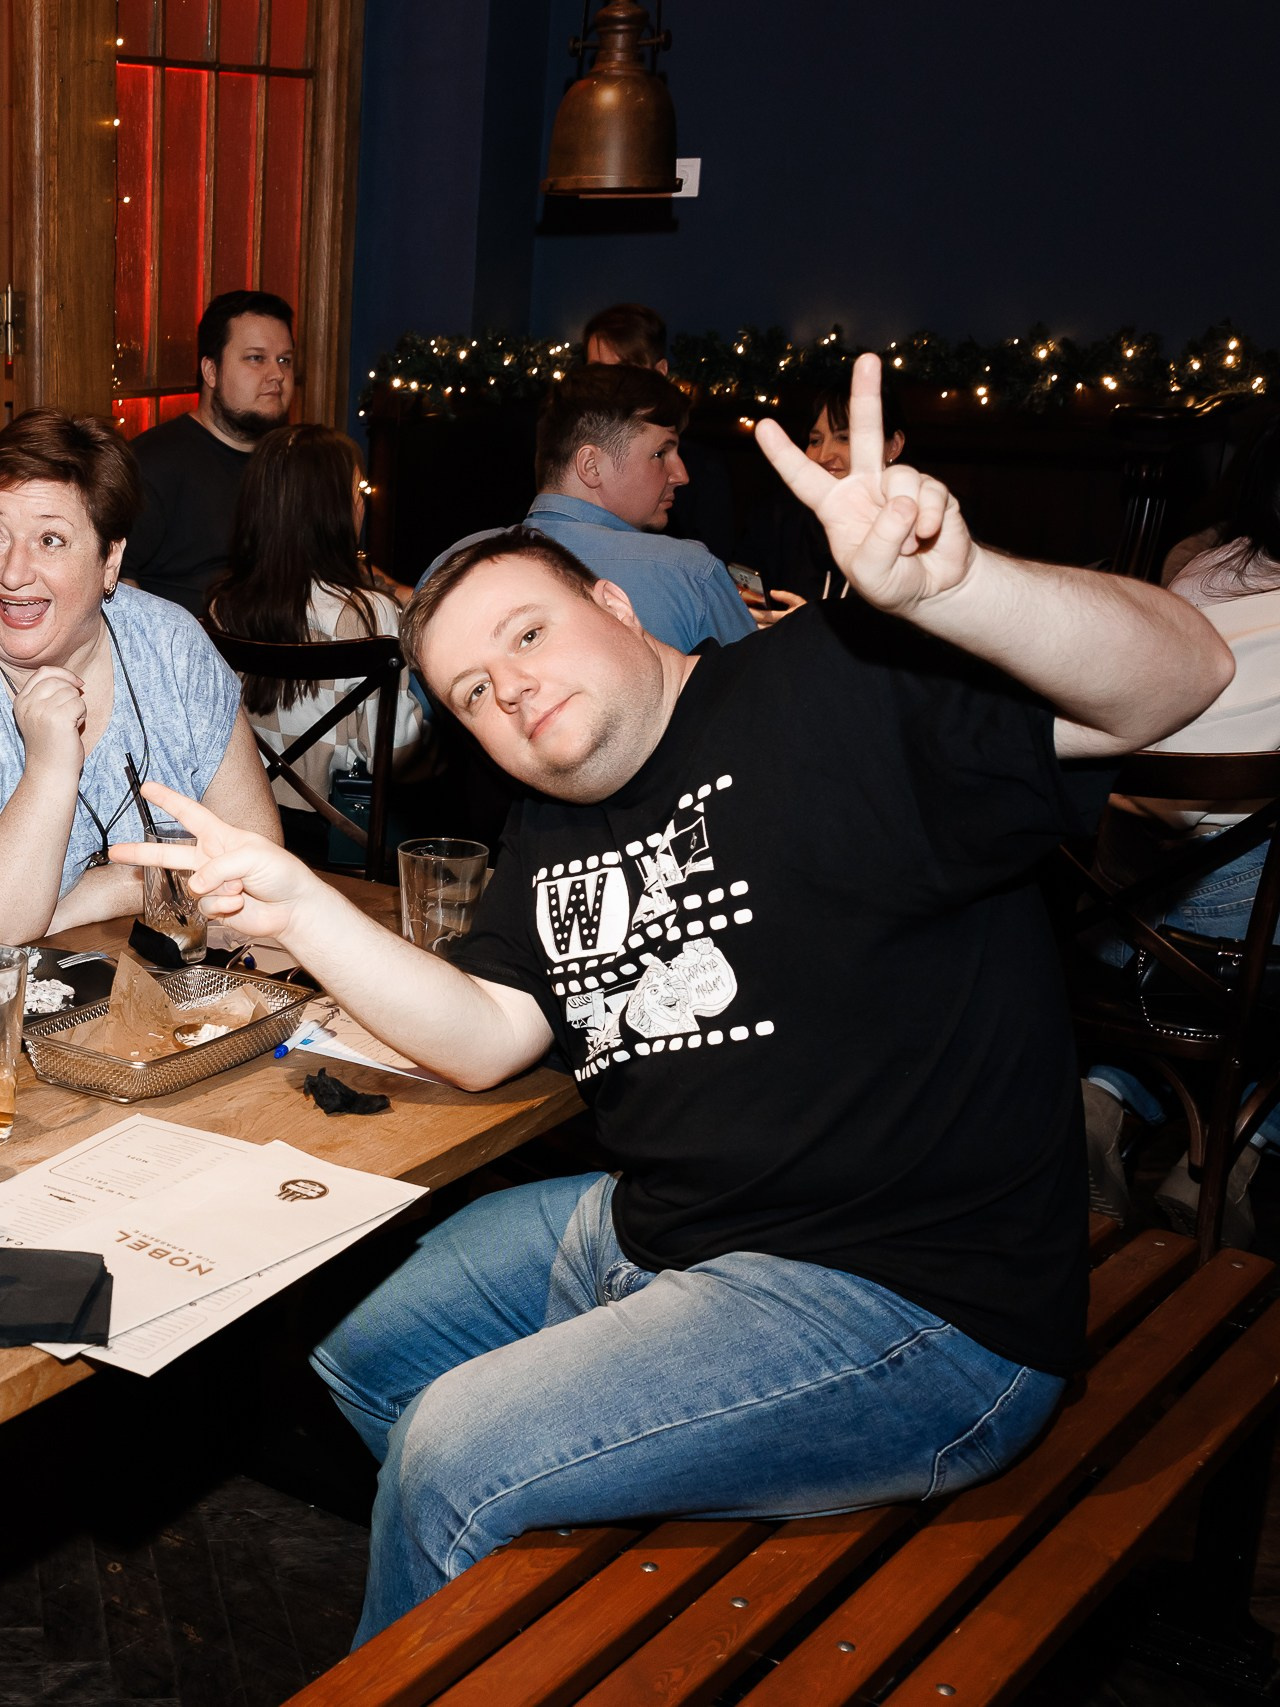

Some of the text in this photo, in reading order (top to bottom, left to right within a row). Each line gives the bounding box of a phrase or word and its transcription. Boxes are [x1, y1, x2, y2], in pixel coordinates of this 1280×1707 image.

[546, 872, 609, 956] W
[568, 994, 593, 1009] UNO
[114, 1229, 215, 1277] NOBEL
[132, 1228, 186, 1253] BRASSERIE
[195, 1254, 217, 1265] PUB
